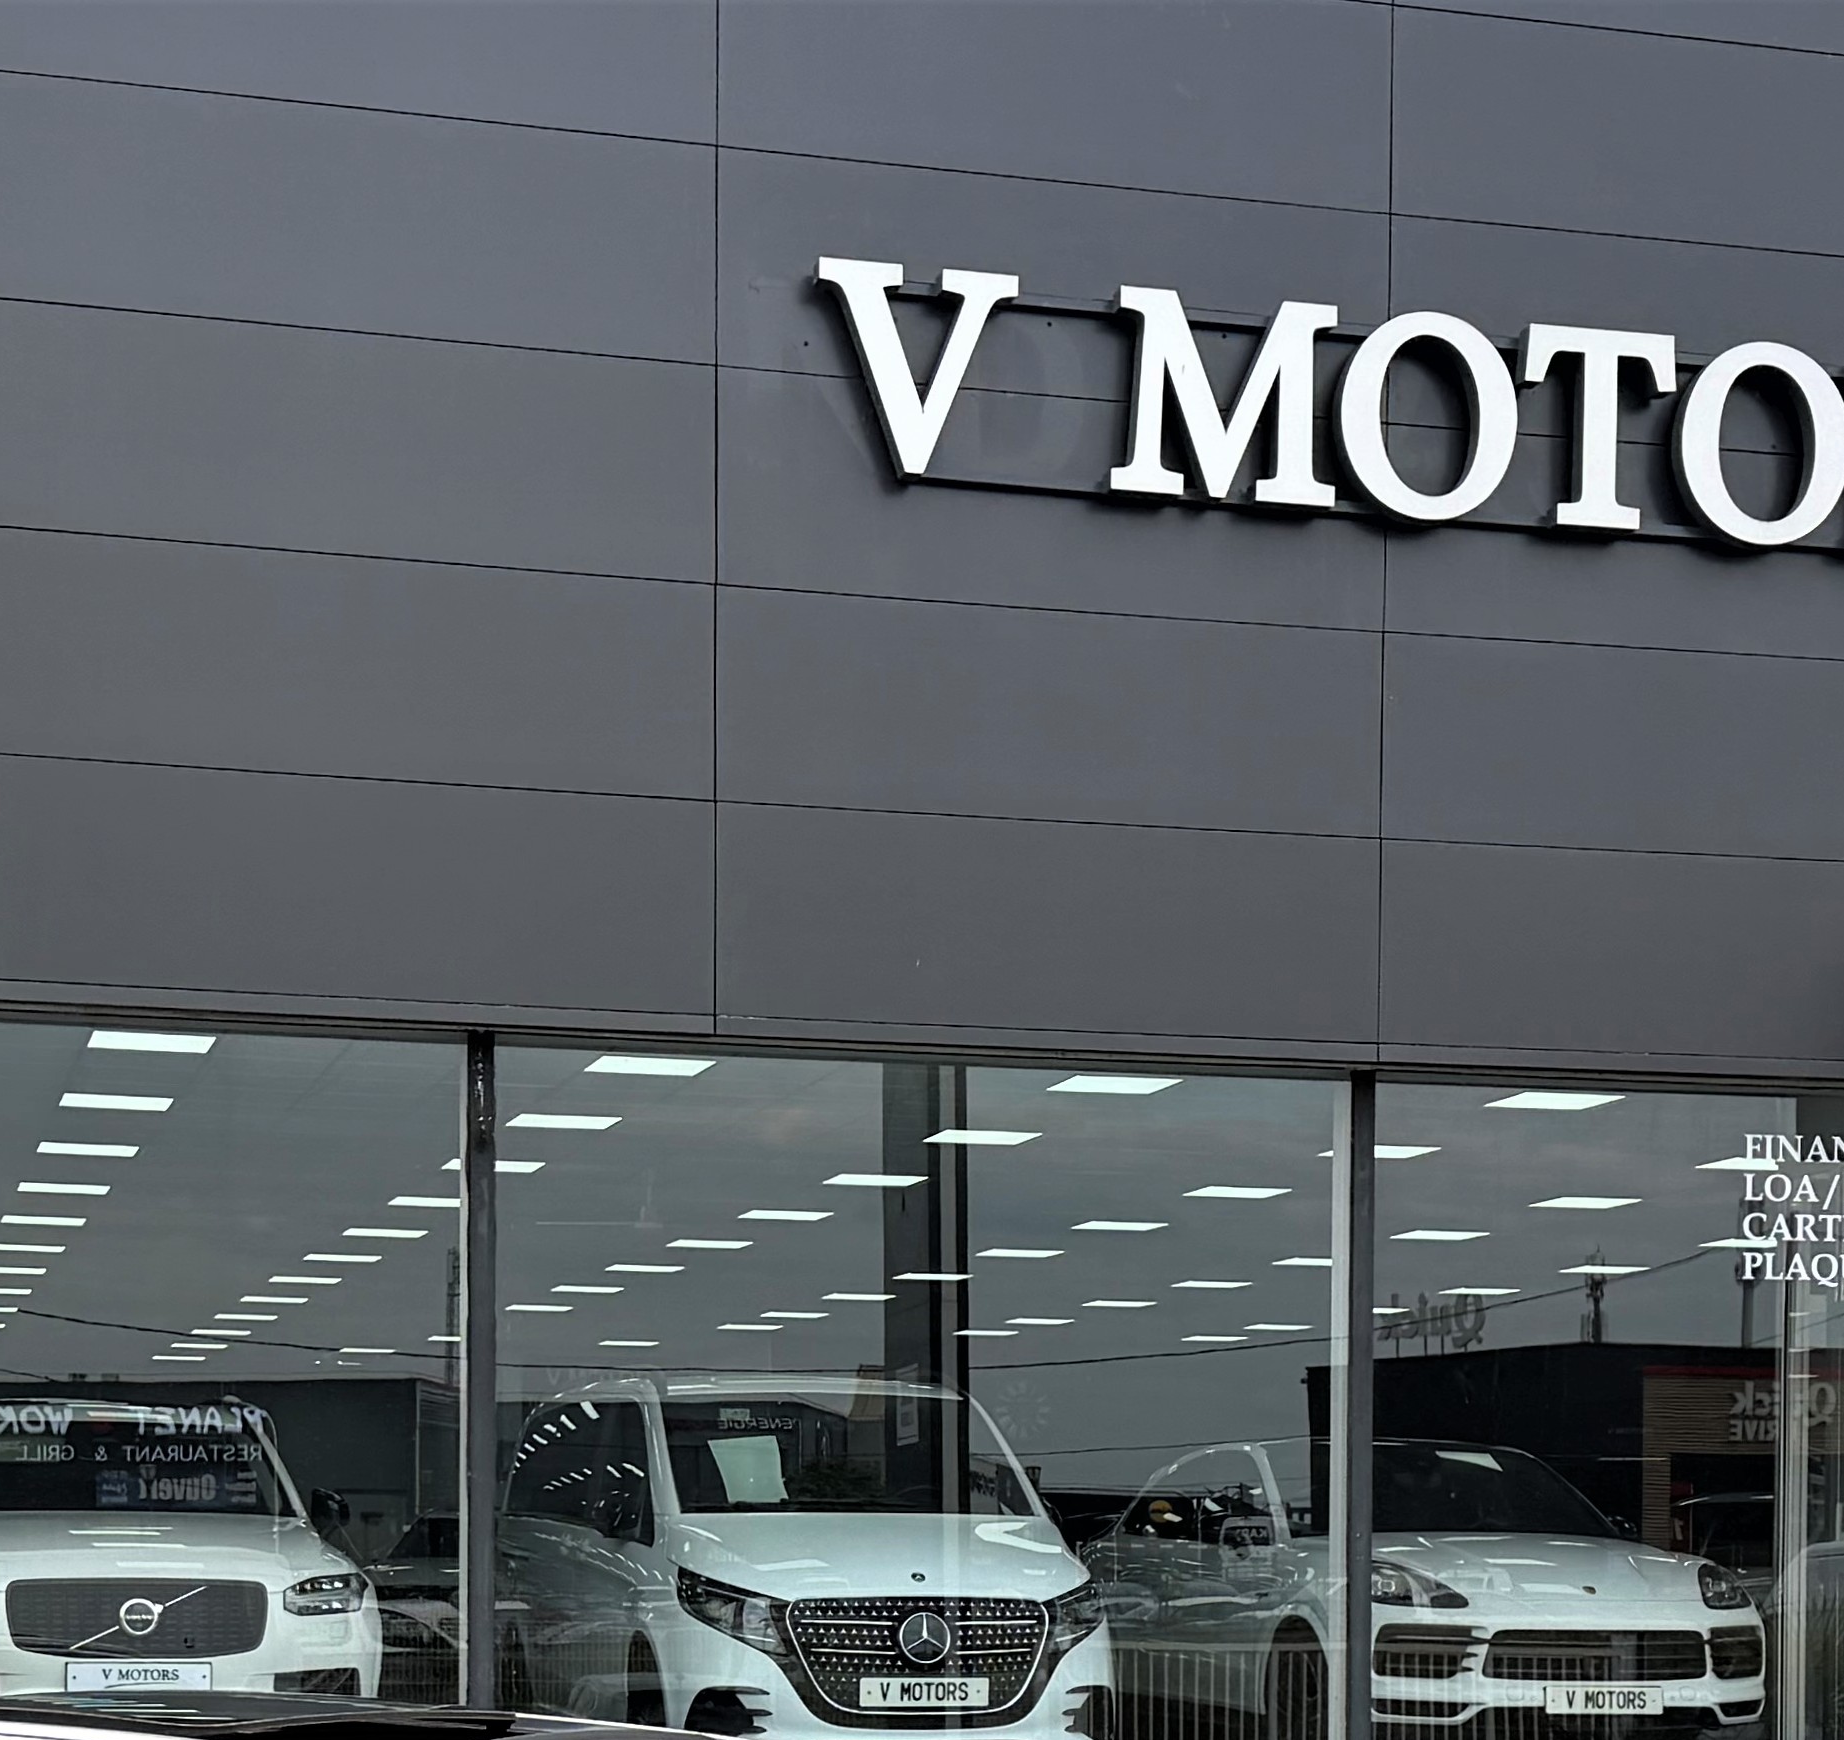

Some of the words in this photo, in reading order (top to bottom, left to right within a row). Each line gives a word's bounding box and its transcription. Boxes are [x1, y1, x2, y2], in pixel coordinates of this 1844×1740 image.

[815, 255, 1020, 480] V
[101, 1669, 112, 1681] V
[118, 1669, 180, 1682] MOTORS
[879, 1682, 891, 1703] V
[900, 1681, 970, 1703] MOTORS
[1565, 1690, 1576, 1709] V
[1584, 1688, 1648, 1711] MOTORS
